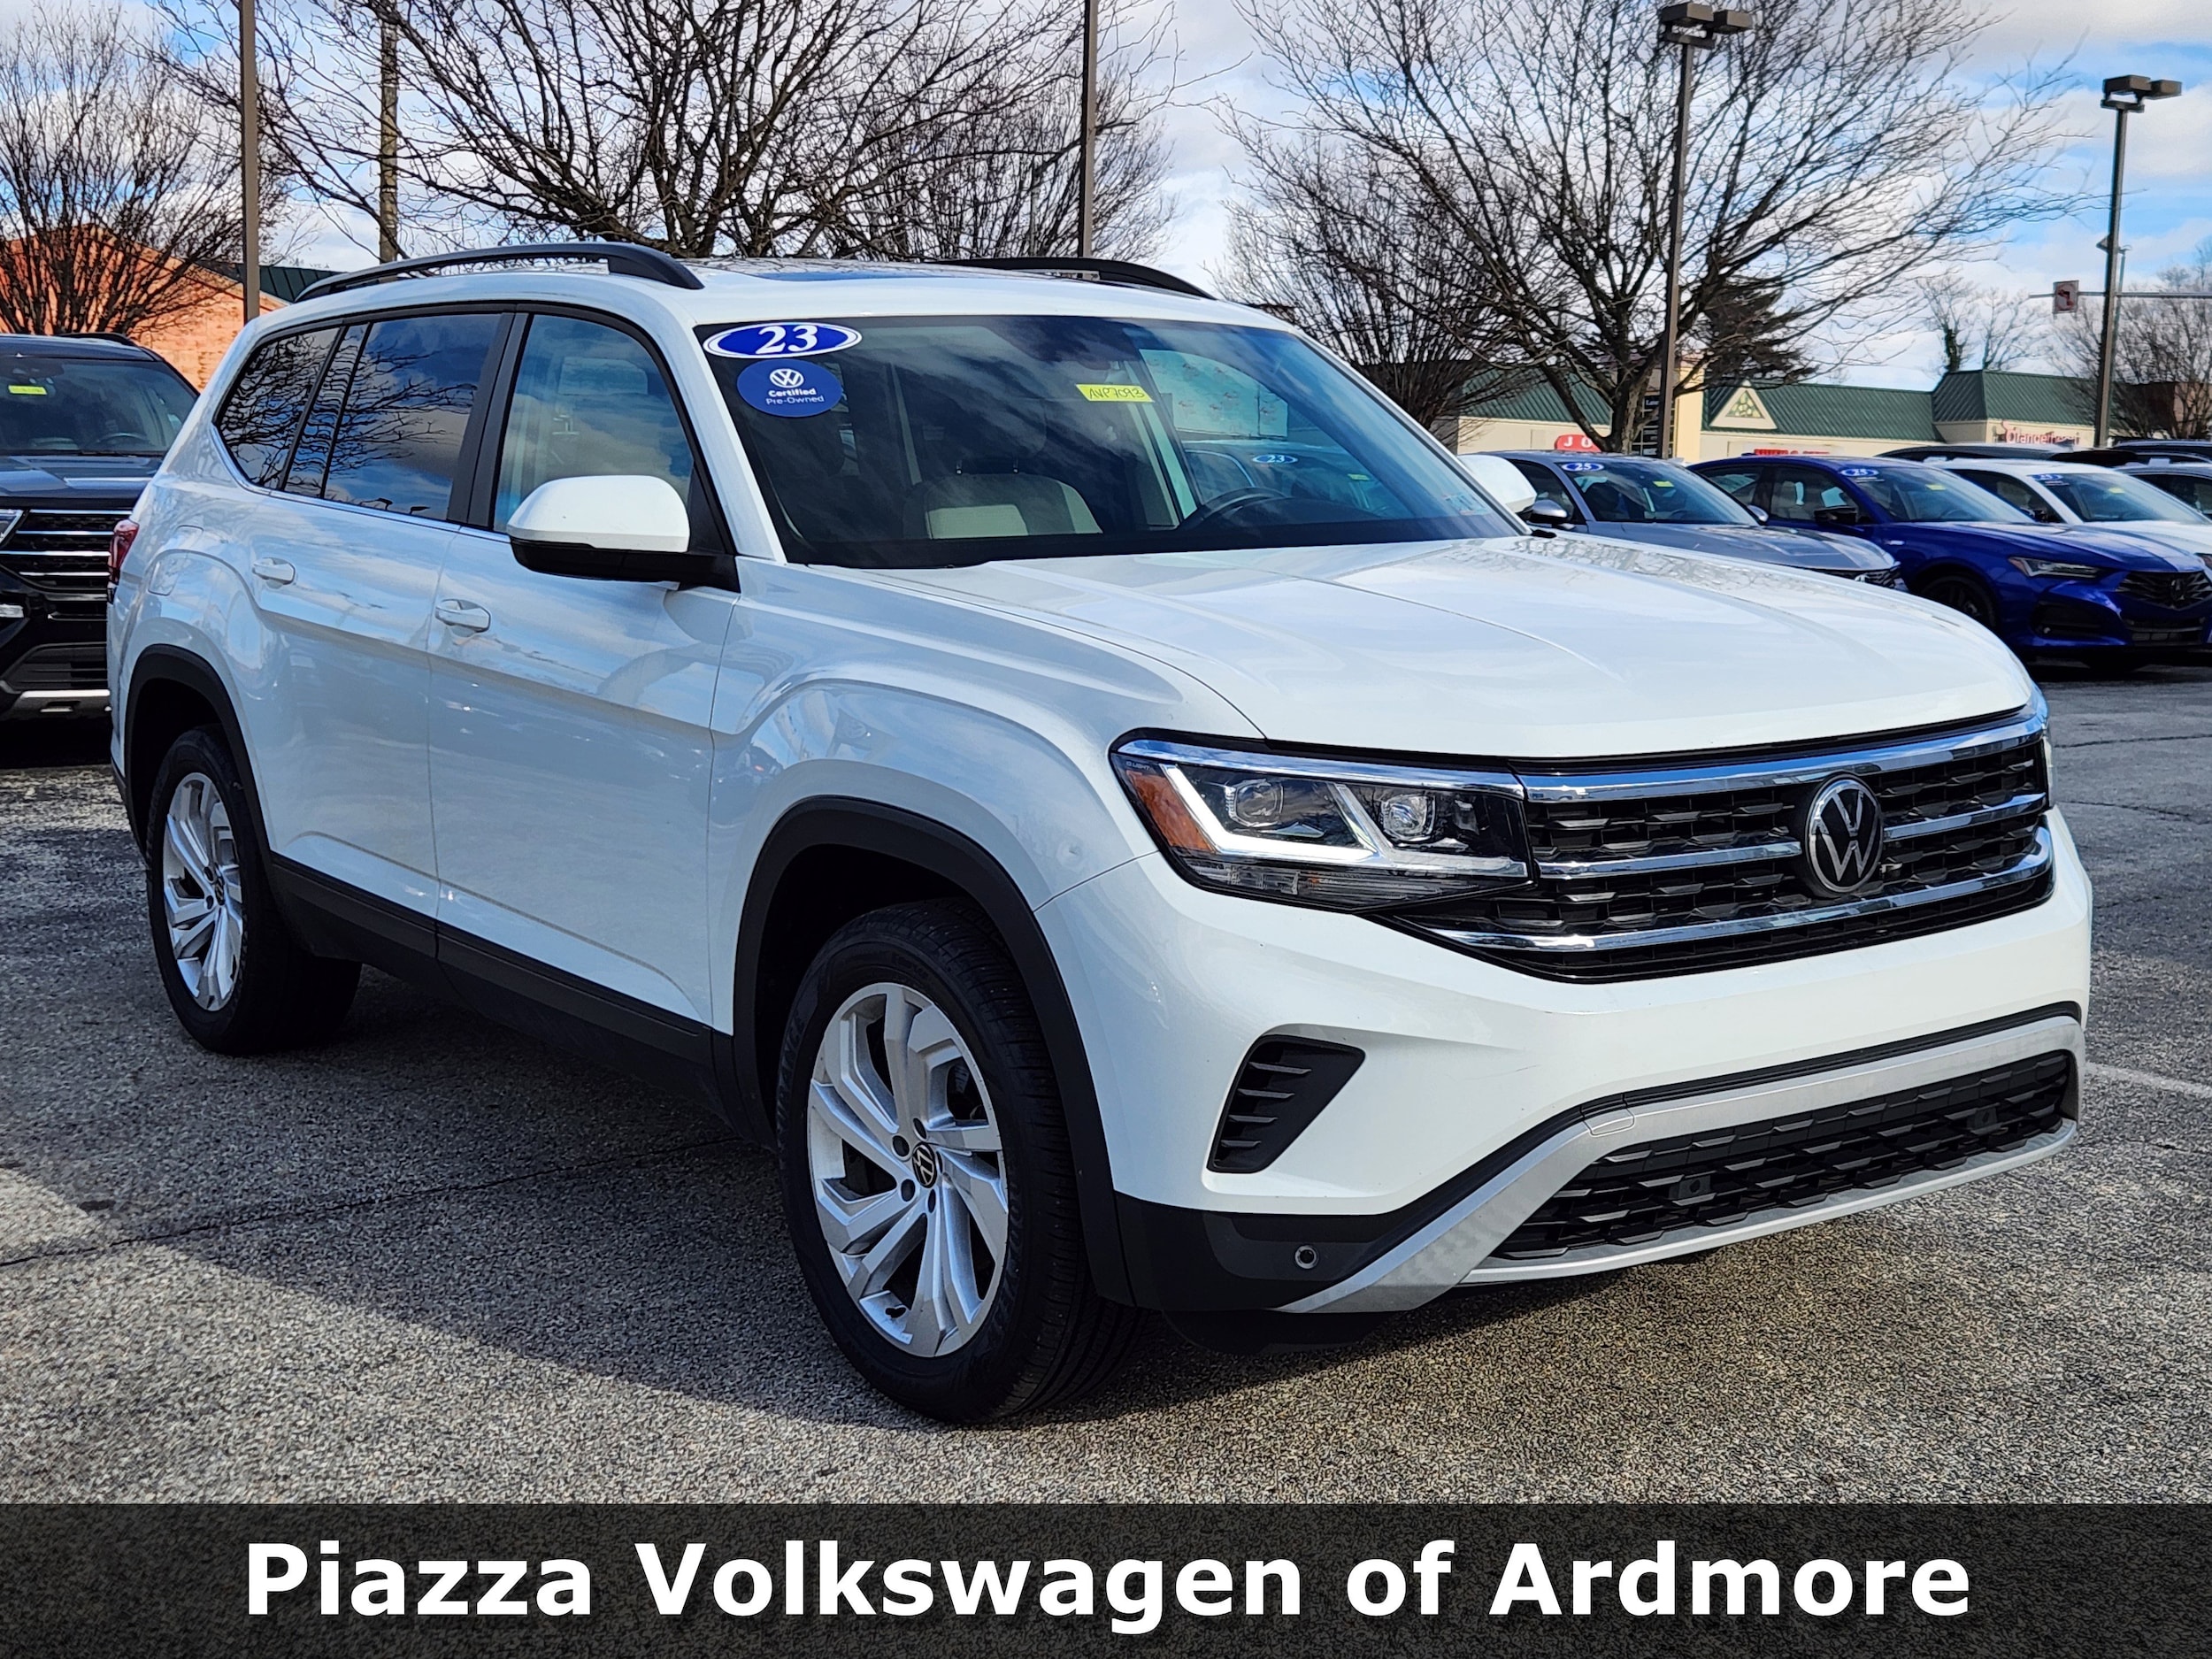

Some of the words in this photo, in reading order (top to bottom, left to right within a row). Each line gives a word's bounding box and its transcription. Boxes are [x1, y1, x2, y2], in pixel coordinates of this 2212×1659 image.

[755, 325, 818, 354] 23
[768, 388, 817, 398] Certified
[765, 395, 825, 406] Pre-Owned
[1266, 454, 1285, 464] 23
